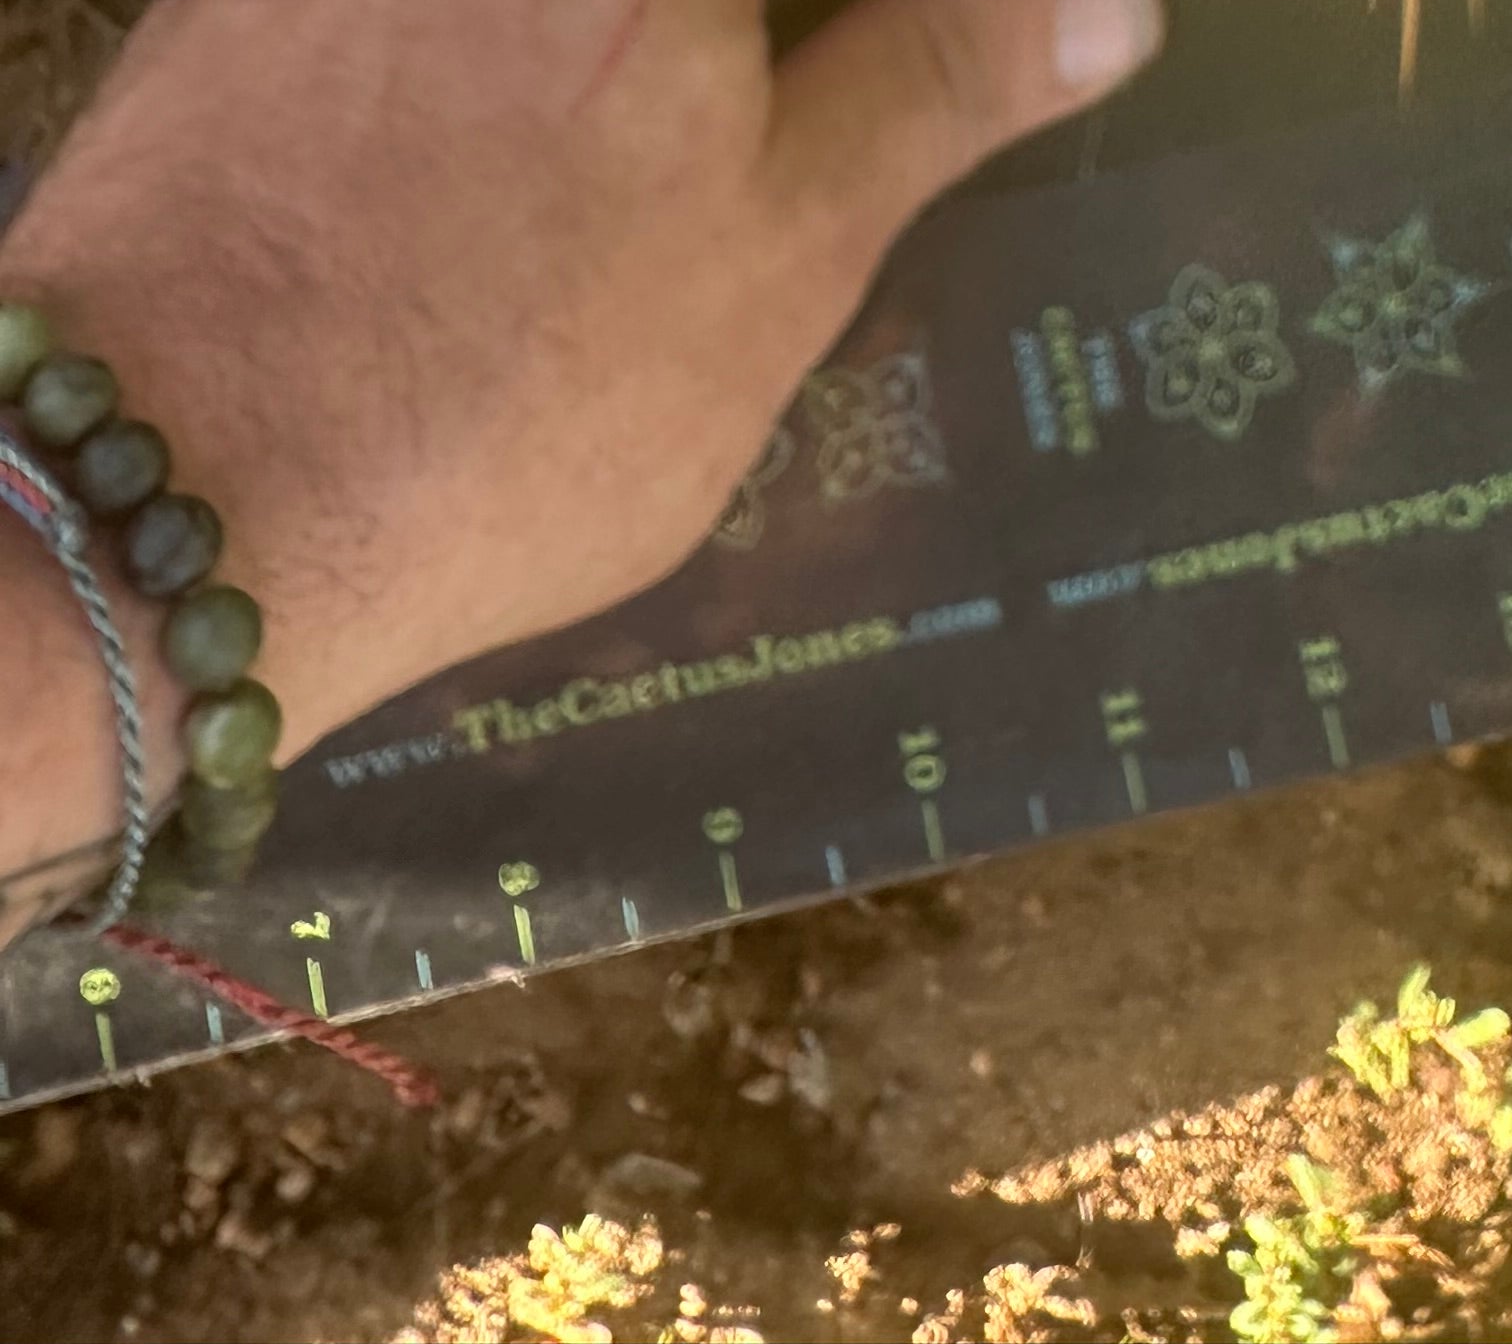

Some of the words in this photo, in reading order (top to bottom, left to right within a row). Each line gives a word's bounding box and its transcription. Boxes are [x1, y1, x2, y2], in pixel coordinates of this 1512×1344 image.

[899, 728, 946, 790] 10
[498, 861, 539, 897] 8
[290, 911, 330, 940] 7
